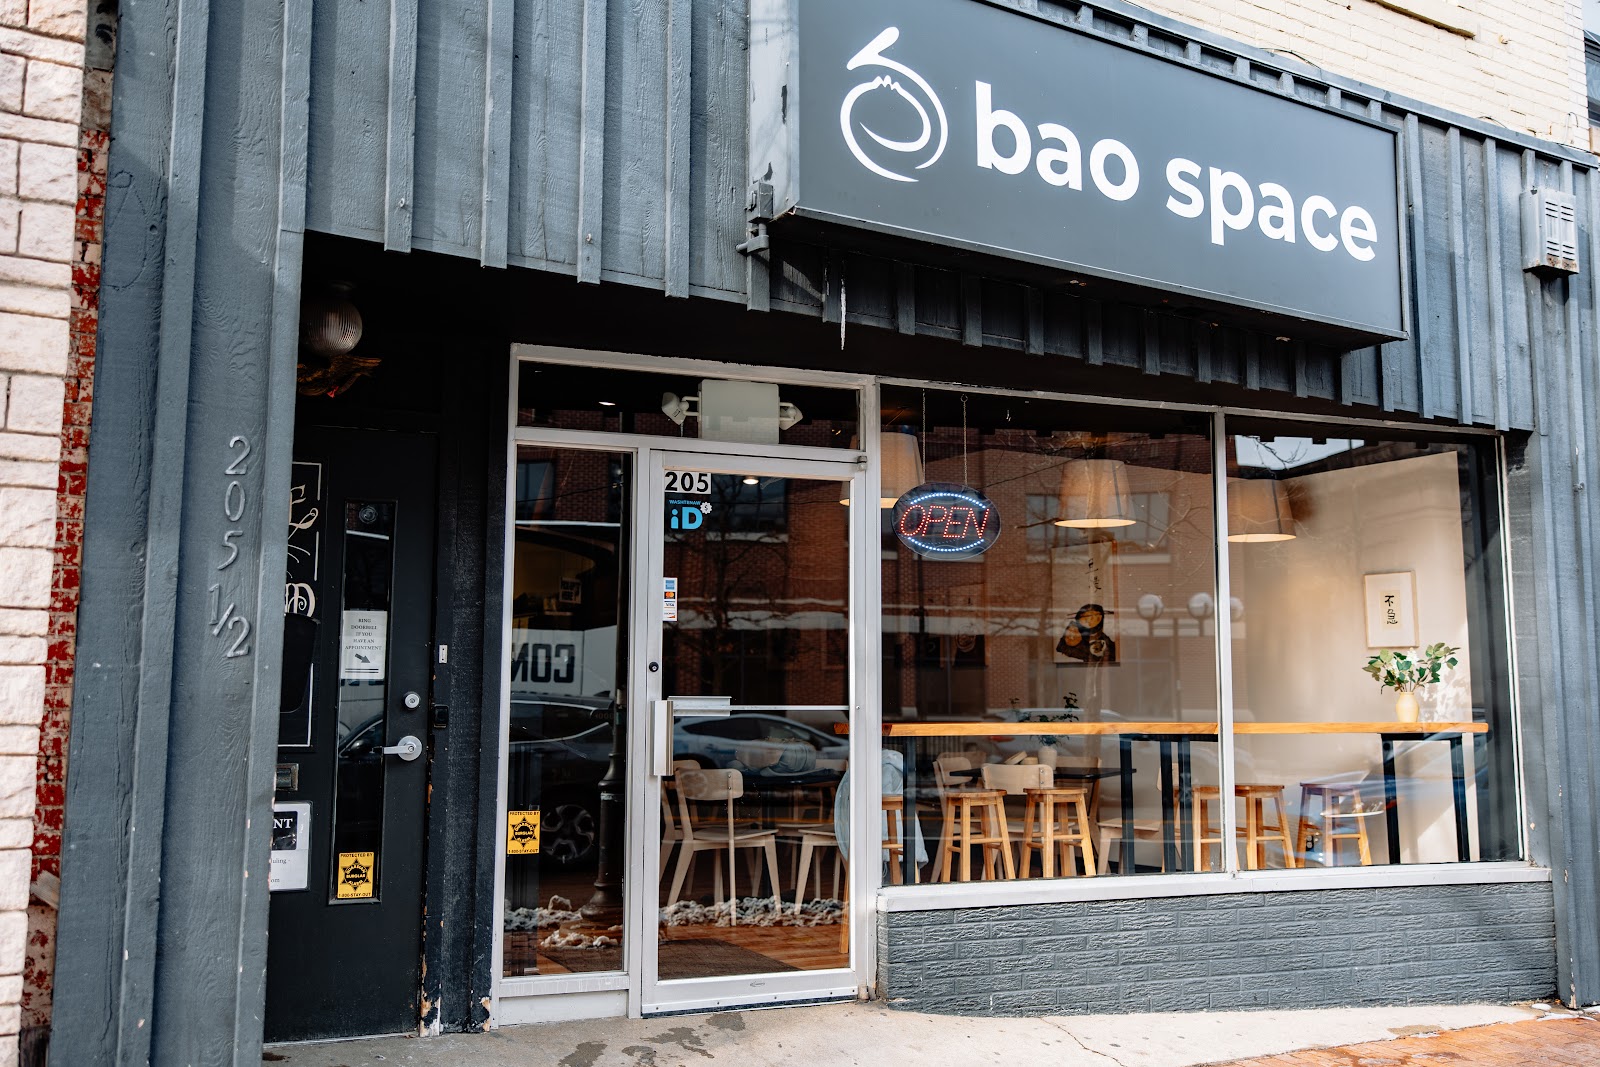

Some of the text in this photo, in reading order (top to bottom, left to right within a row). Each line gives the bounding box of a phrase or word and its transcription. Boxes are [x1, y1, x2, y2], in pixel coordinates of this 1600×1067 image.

[976, 80, 1378, 262] bao space
[664, 471, 709, 492] 205
[670, 506, 703, 530] iD
[900, 504, 990, 539] OPEN
